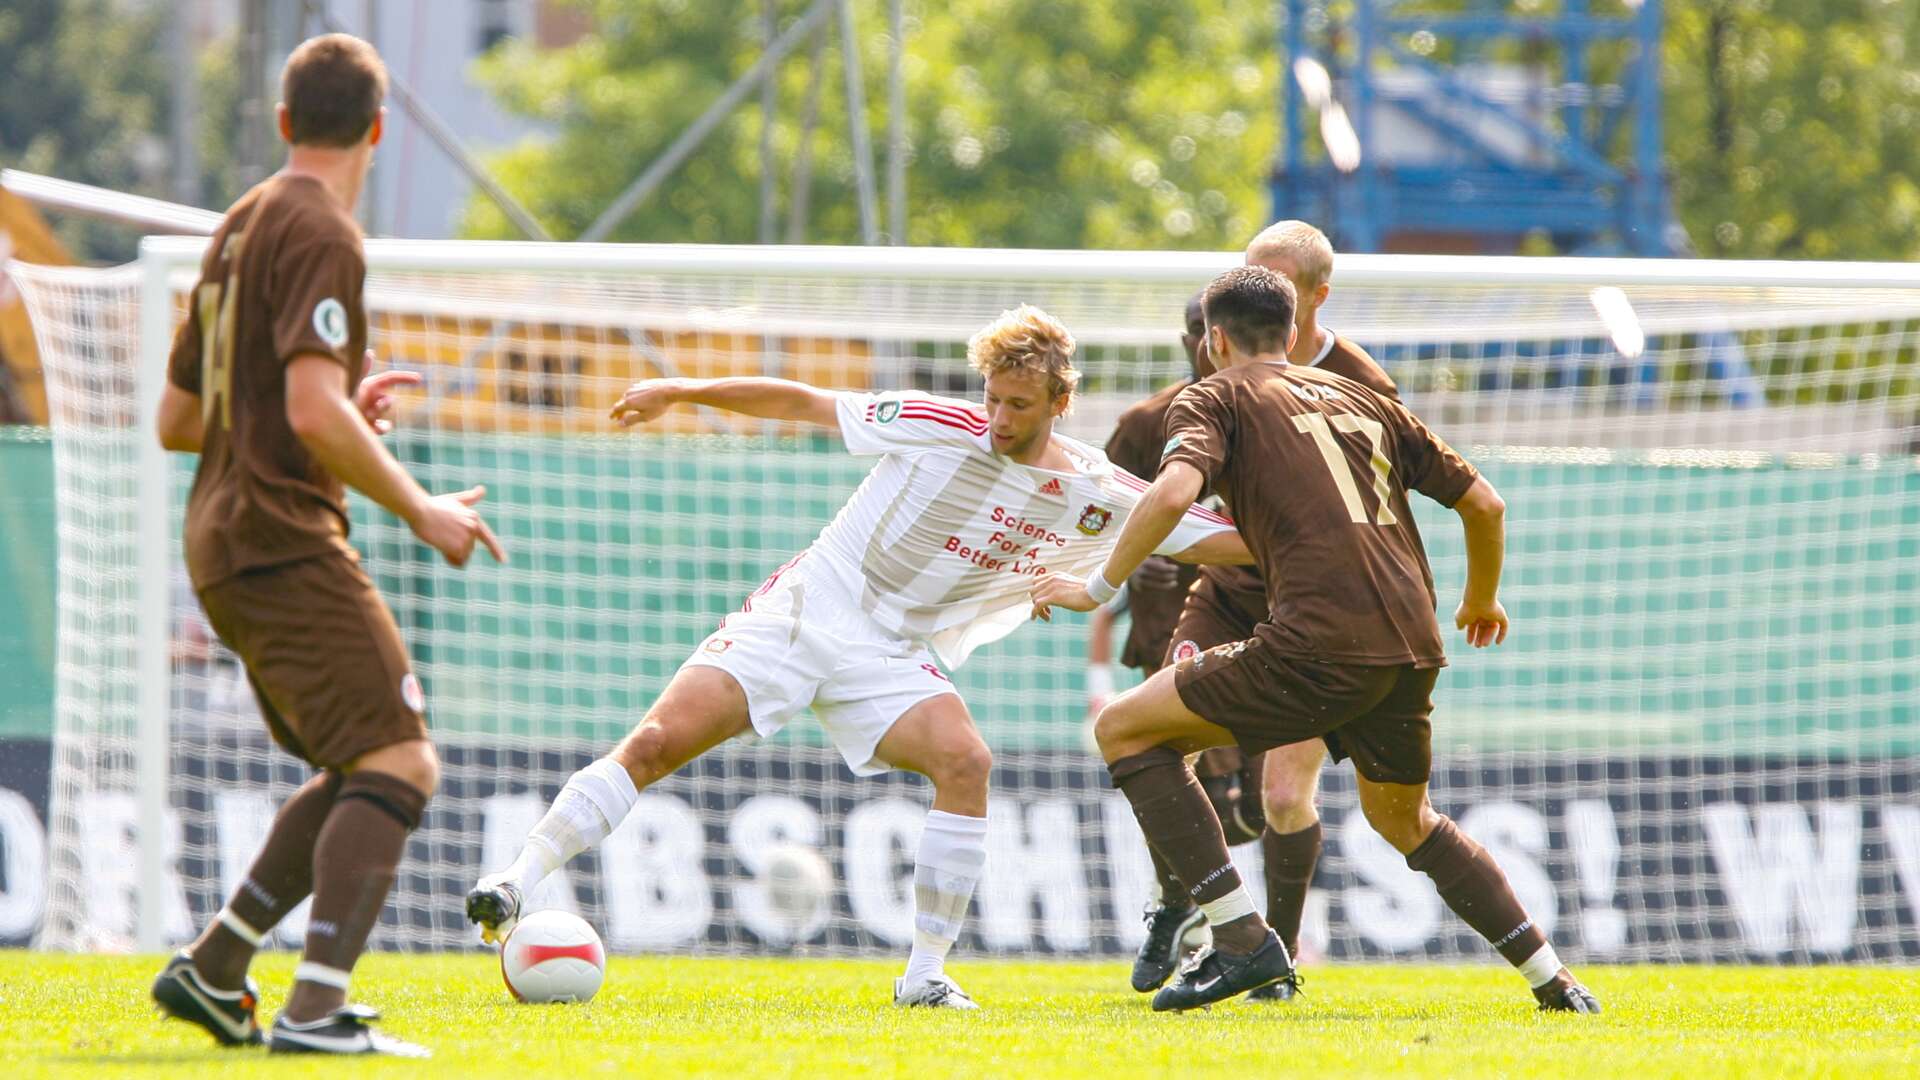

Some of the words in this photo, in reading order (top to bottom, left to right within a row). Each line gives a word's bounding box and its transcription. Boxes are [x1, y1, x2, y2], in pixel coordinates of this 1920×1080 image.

[1291, 411, 1397, 526] 17
[988, 531, 1022, 554] For
[1024, 547, 1040, 560] A
[990, 506, 1066, 547] Science
[944, 535, 1008, 571] Better
